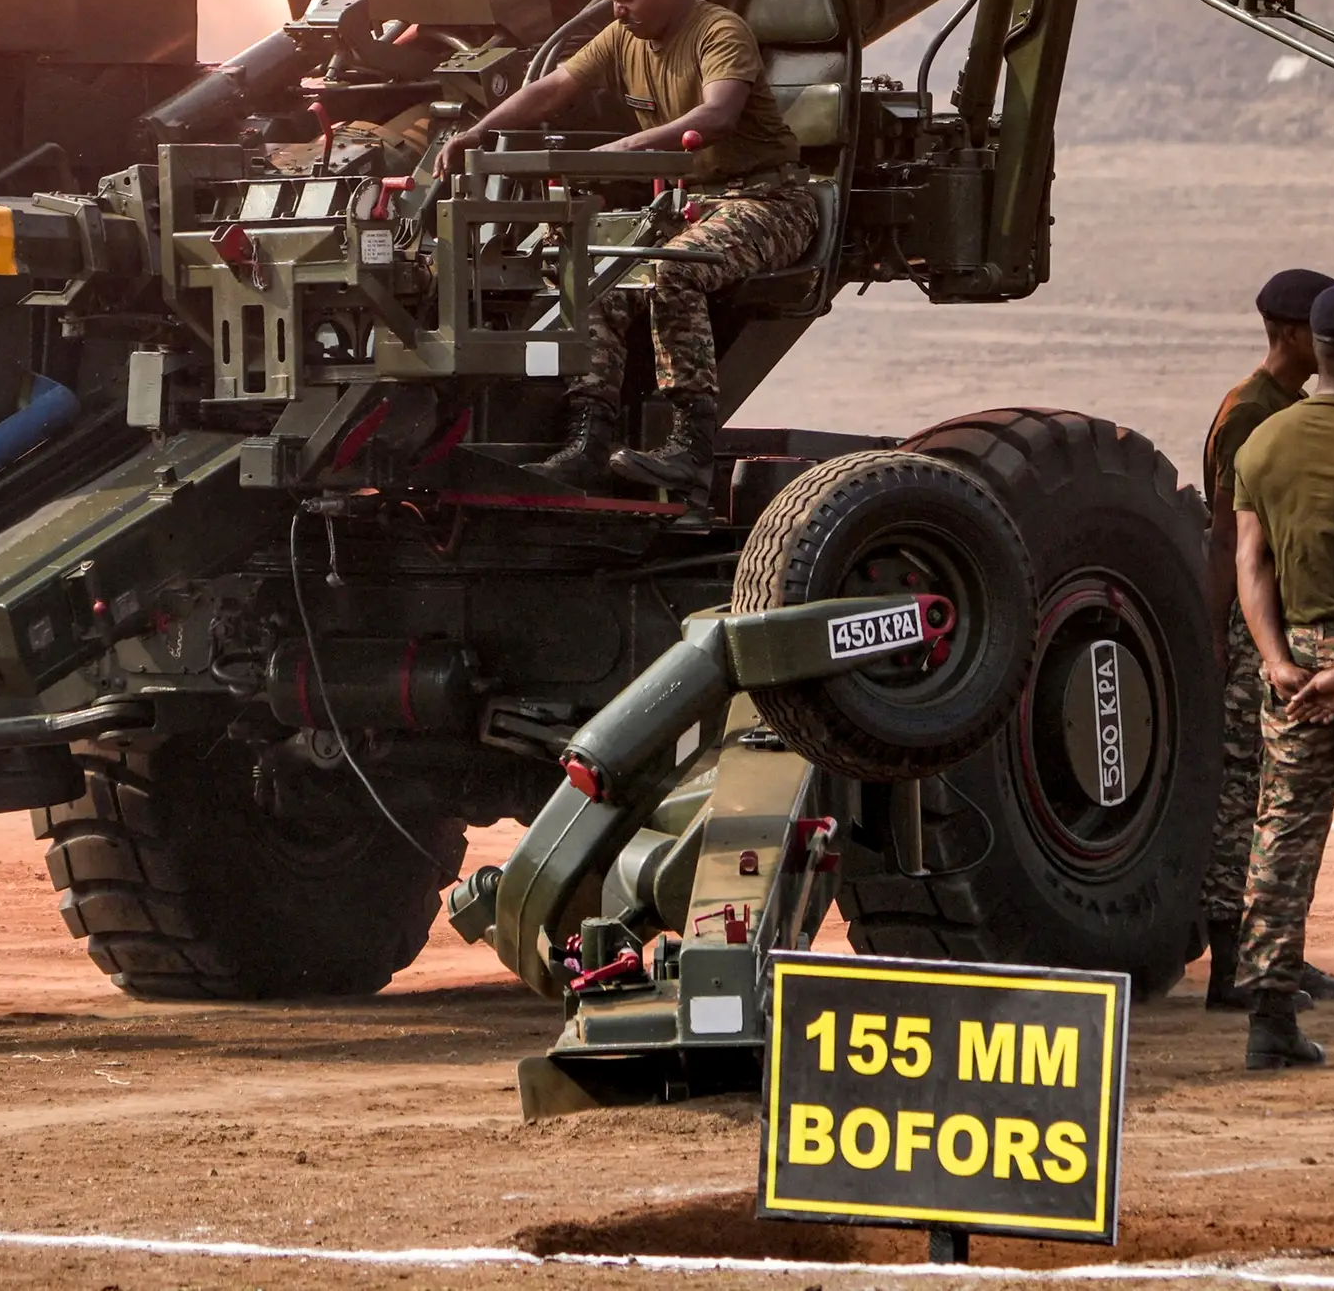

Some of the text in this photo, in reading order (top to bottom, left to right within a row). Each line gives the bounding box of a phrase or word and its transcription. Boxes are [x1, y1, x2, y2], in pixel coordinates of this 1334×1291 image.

[836, 612, 916, 649] 450 KPA
[1098, 658, 1120, 787] 500 KPA
[805, 1011, 1079, 1088] 155 MM
[788, 1103, 1087, 1184] BOFORS
